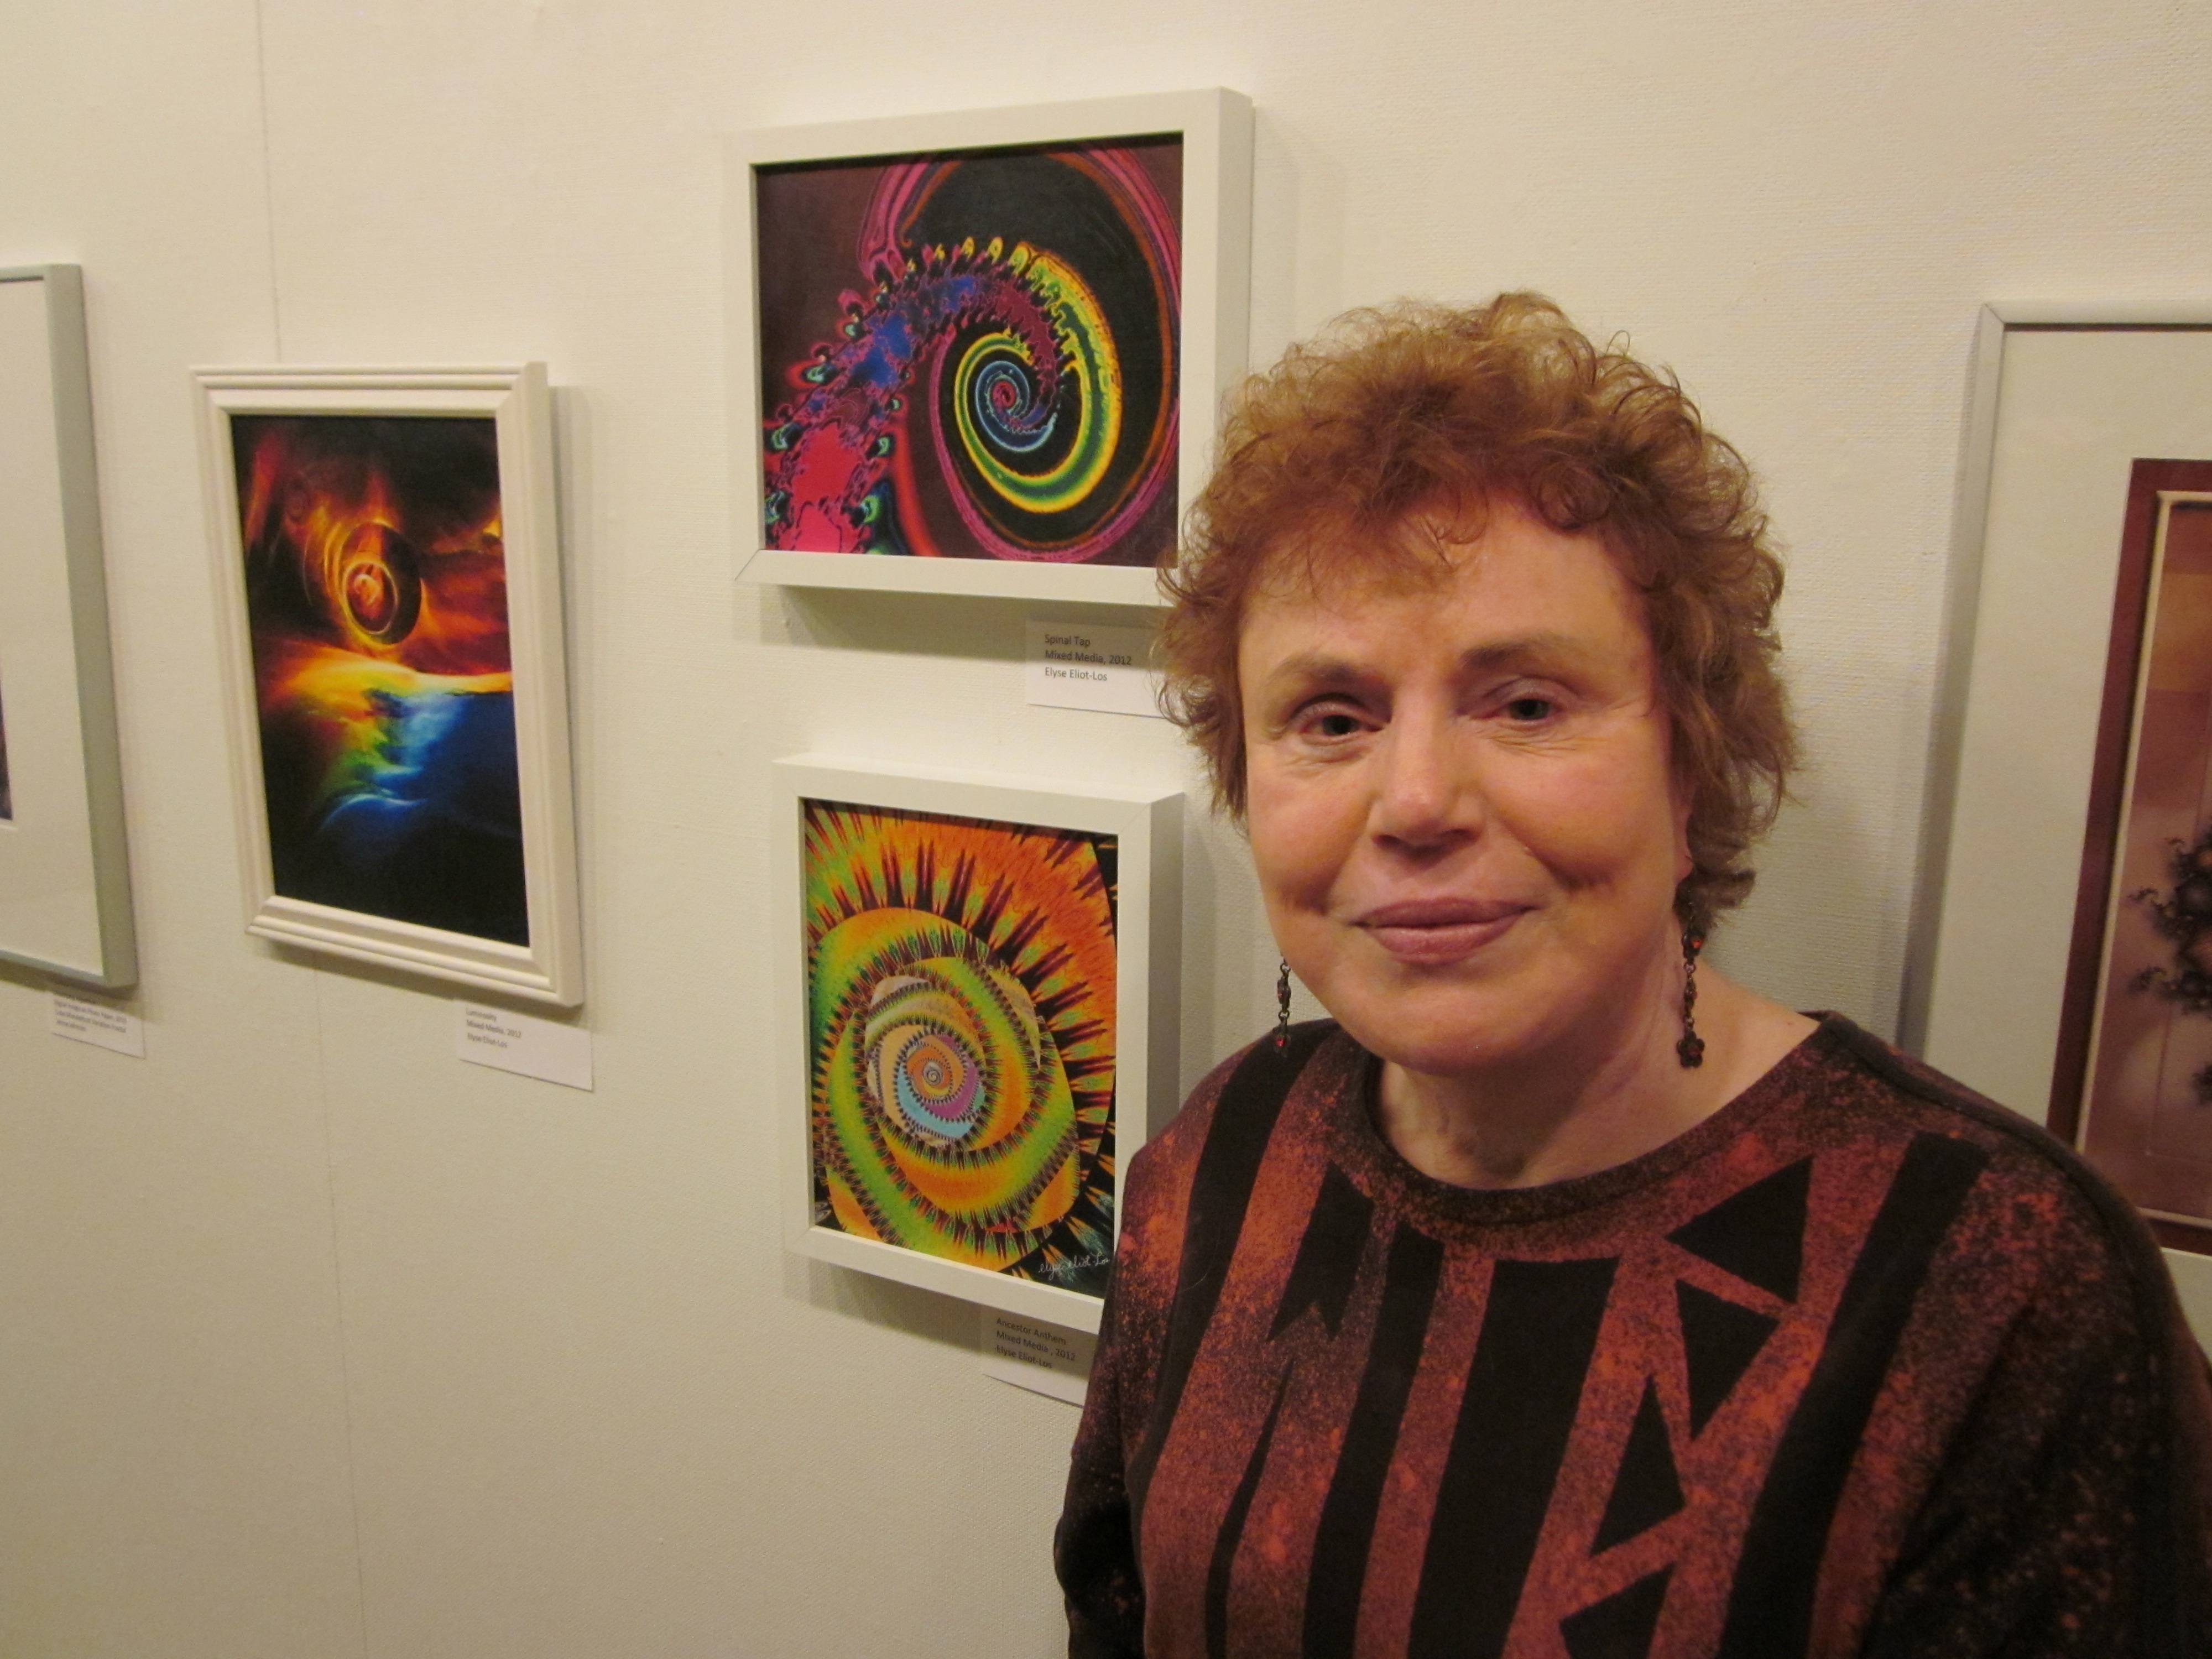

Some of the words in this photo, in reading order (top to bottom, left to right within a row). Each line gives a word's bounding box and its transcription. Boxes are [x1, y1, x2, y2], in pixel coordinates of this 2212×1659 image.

[1045, 634, 1071, 646] Spinal
[1074, 636, 1091, 647] Tap
[1045, 650, 1072, 661] Mixed
[1075, 652, 1106, 665] Media,
[1109, 655, 1131, 665] 2012
[1045, 667, 1067, 680] Elyse
[1070, 669, 1108, 681] Eliot-Los
[997, 1318, 1031, 1334] Ancestor
[1034, 1329, 1066, 1345] Anthem
[997, 1331, 1021, 1344] Mixed
[1055, 1348, 1076, 1361] 2012
[997, 1344, 1017, 1358] Elyse
